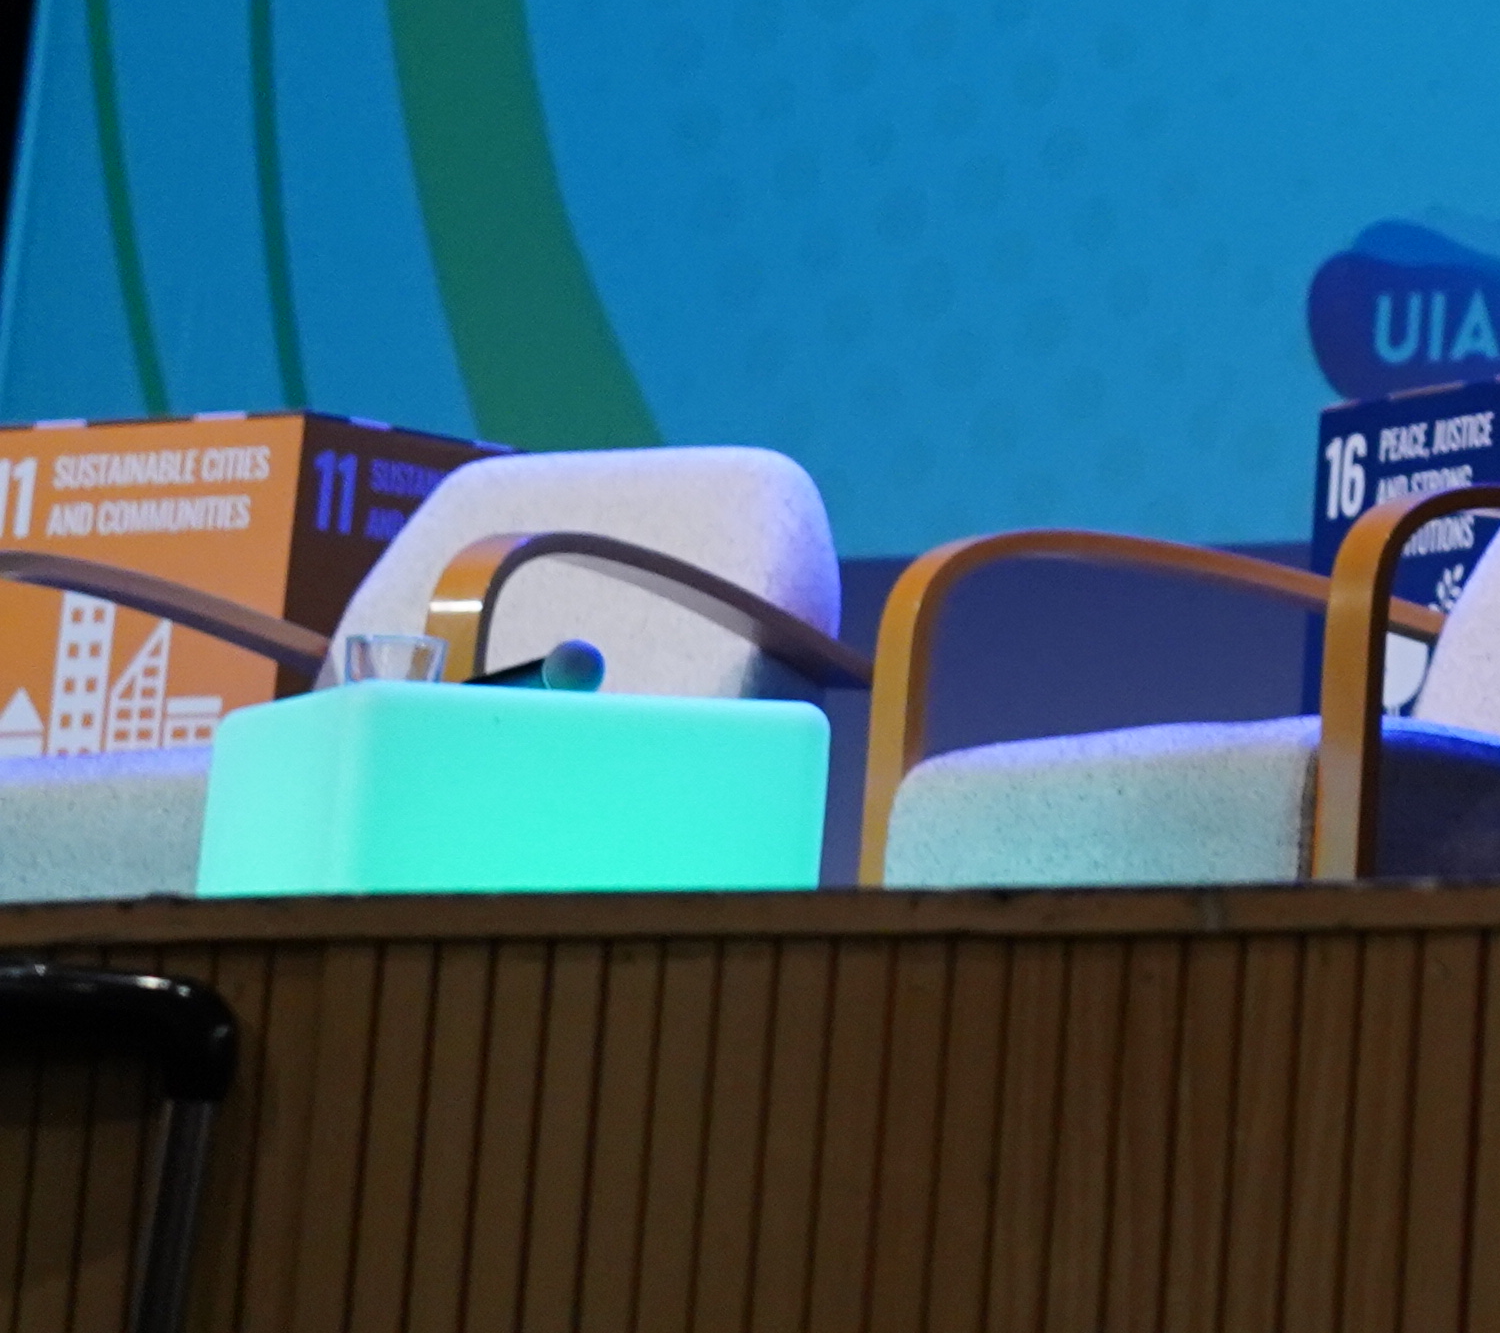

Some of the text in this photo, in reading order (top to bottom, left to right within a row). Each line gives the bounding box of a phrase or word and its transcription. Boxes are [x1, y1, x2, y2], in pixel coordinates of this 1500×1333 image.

[1373, 290, 1500, 363] UIA
[54, 449, 198, 490] SUSTAINABLE
[202, 446, 270, 483] CITIES
[314, 450, 358, 532] 11
[1325, 434, 1367, 520] 16
[1432, 411, 1494, 454] JUSTICE
[47, 494, 250, 536] AND COMMUNITIES
